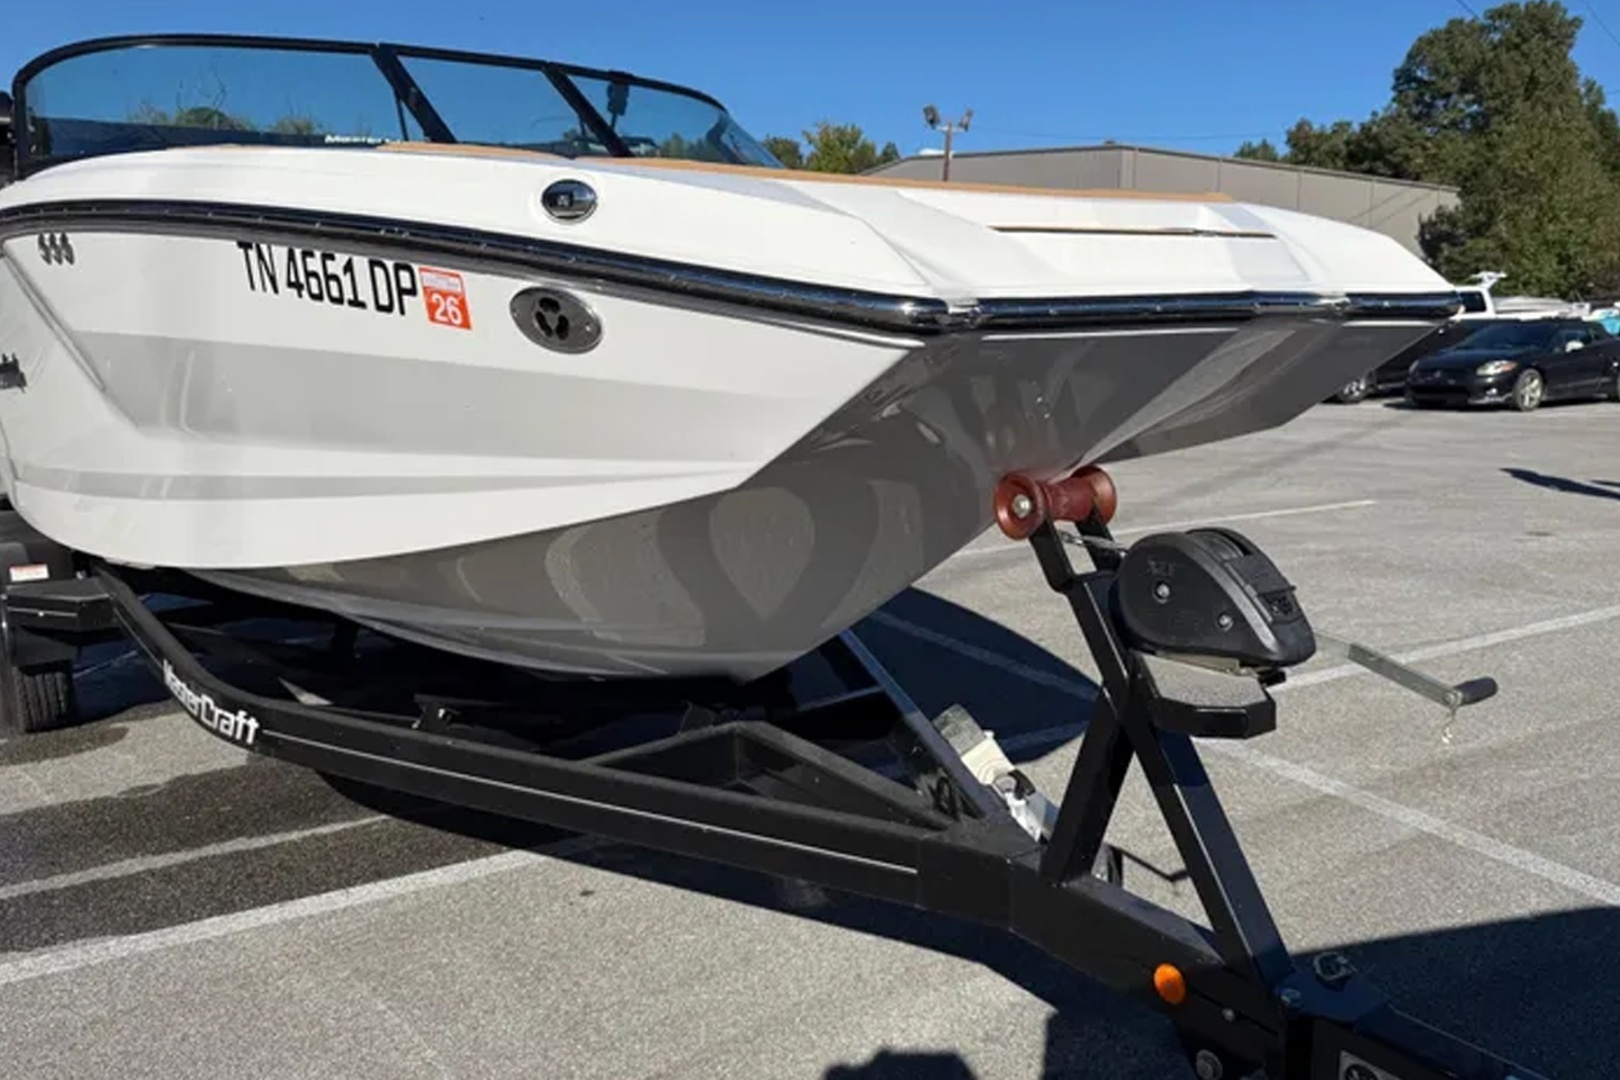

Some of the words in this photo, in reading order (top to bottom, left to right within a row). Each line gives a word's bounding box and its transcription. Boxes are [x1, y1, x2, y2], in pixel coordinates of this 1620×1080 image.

[237, 241, 279, 296] TN
[286, 247, 367, 309] 4661
[369, 258, 418, 316] DP
[432, 292, 462, 326] 26
